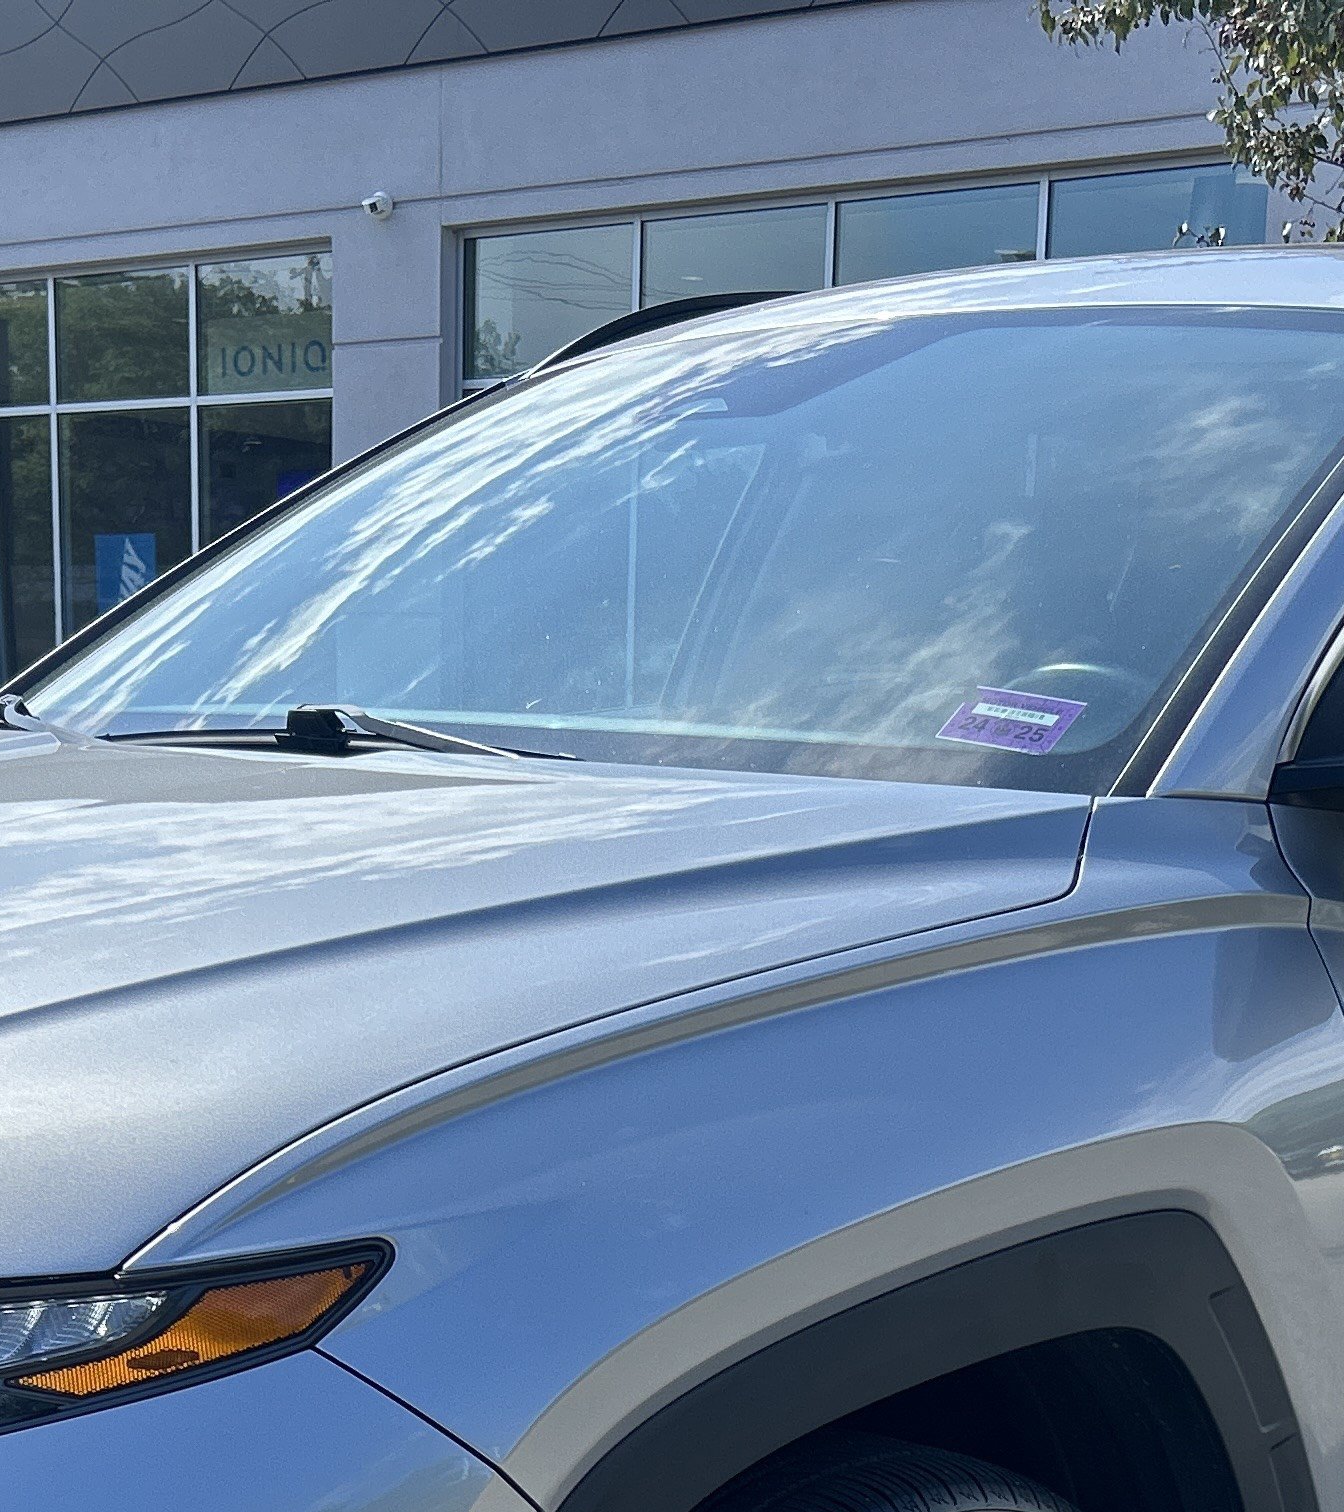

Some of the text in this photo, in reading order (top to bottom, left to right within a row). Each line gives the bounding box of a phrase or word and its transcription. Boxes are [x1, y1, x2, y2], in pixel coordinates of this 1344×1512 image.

[221, 340, 327, 378] IONIQ
[958, 715, 1052, 743] 24 25
